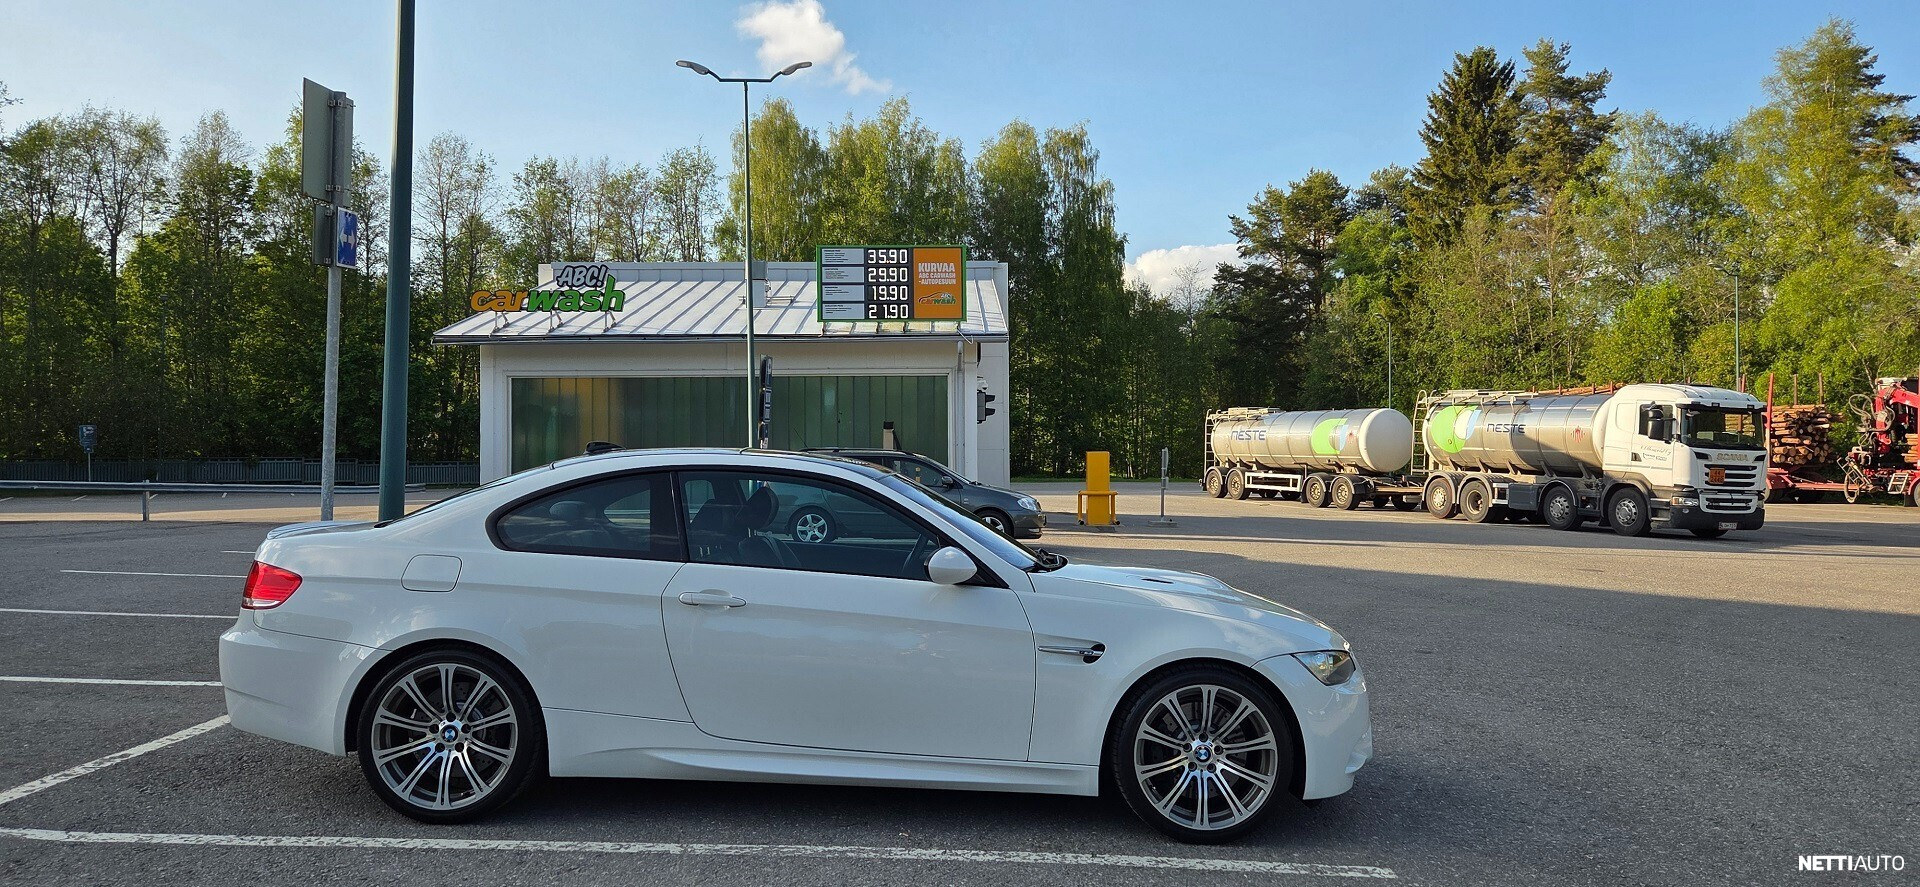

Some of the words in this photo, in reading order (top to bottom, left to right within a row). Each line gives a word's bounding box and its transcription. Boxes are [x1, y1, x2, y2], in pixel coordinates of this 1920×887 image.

[867, 249, 908, 264] 35.90
[867, 267, 908, 282] 29.90
[918, 262, 956, 272] KURVAA
[557, 264, 609, 287] ABC!
[470, 274, 625, 312] carwash
[872, 285, 908, 301] 19.90
[1230, 430, 1267, 441] NESTE
[1486, 423, 1527, 434] NESTE
